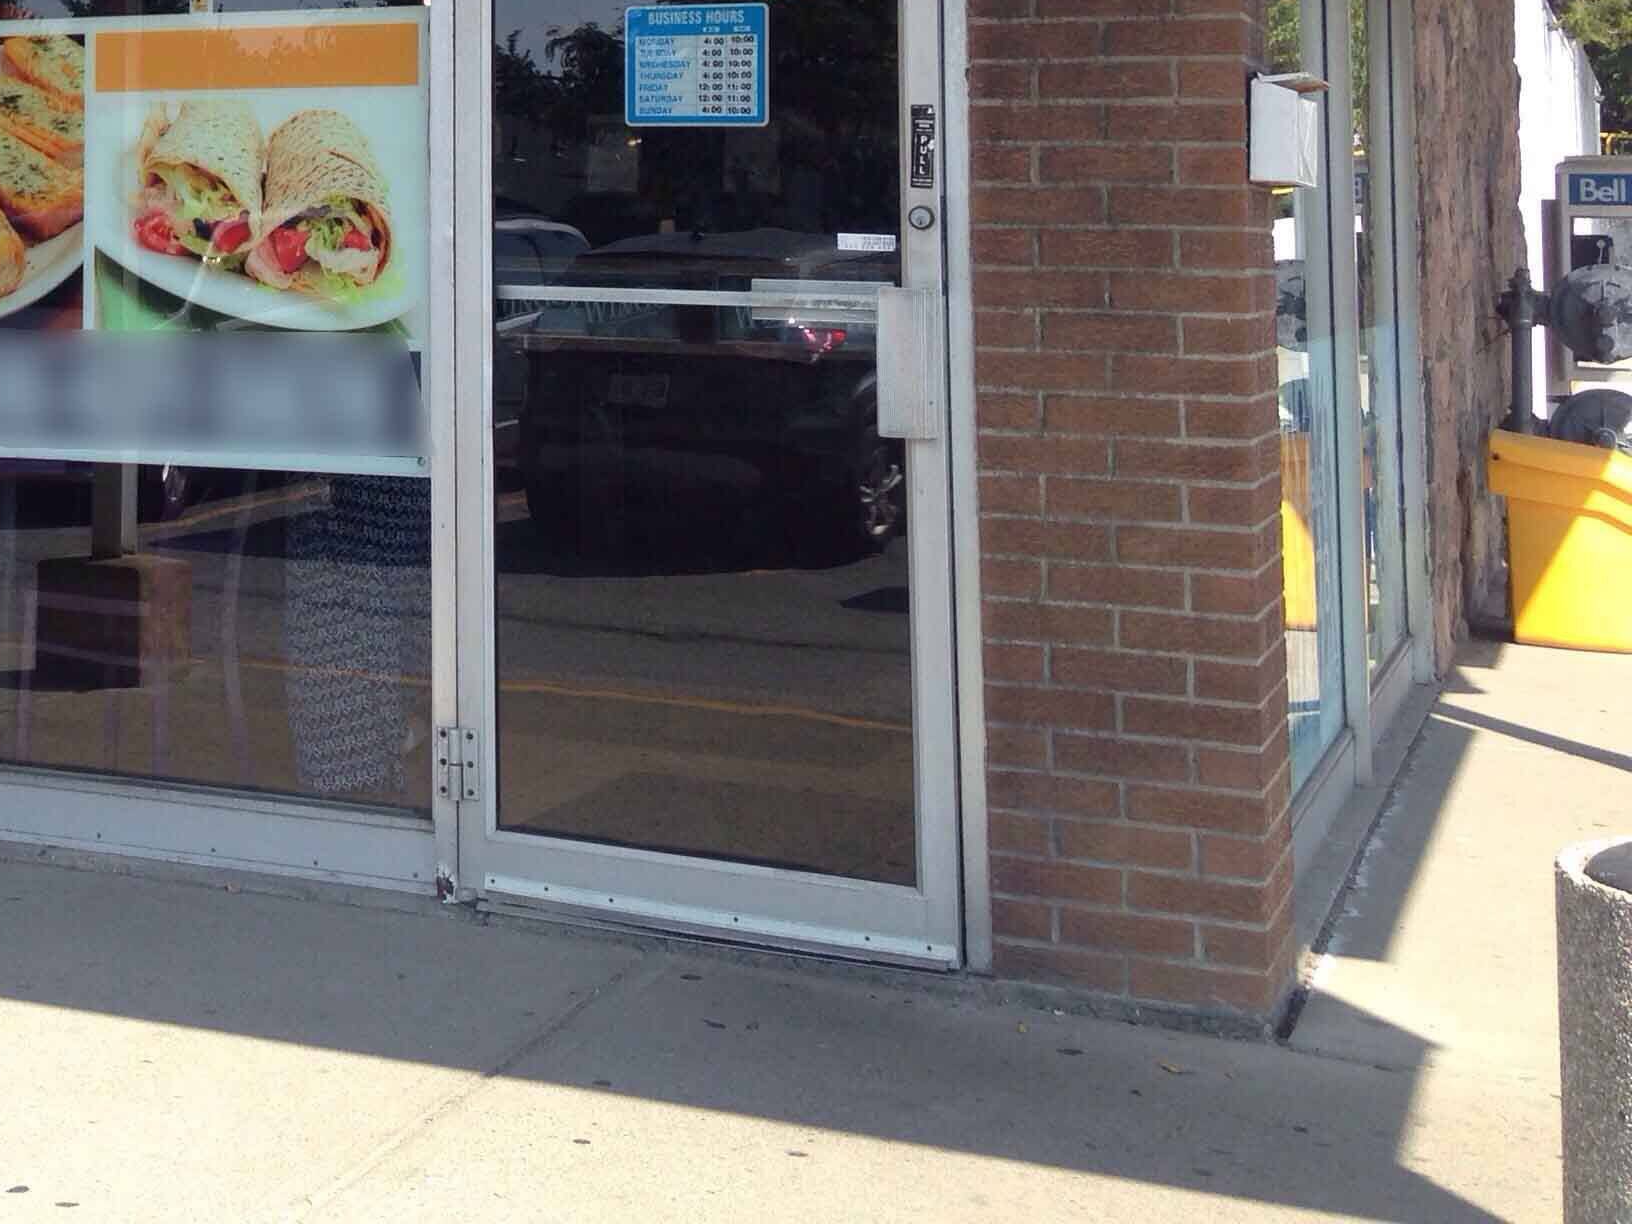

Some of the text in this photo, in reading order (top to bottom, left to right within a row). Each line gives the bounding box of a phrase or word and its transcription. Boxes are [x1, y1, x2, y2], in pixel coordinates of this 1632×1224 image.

[648, 9, 745, 25] BUSINESS HOURS
[919, 135, 928, 175] PULL
[1580, 178, 1626, 202] Bell
